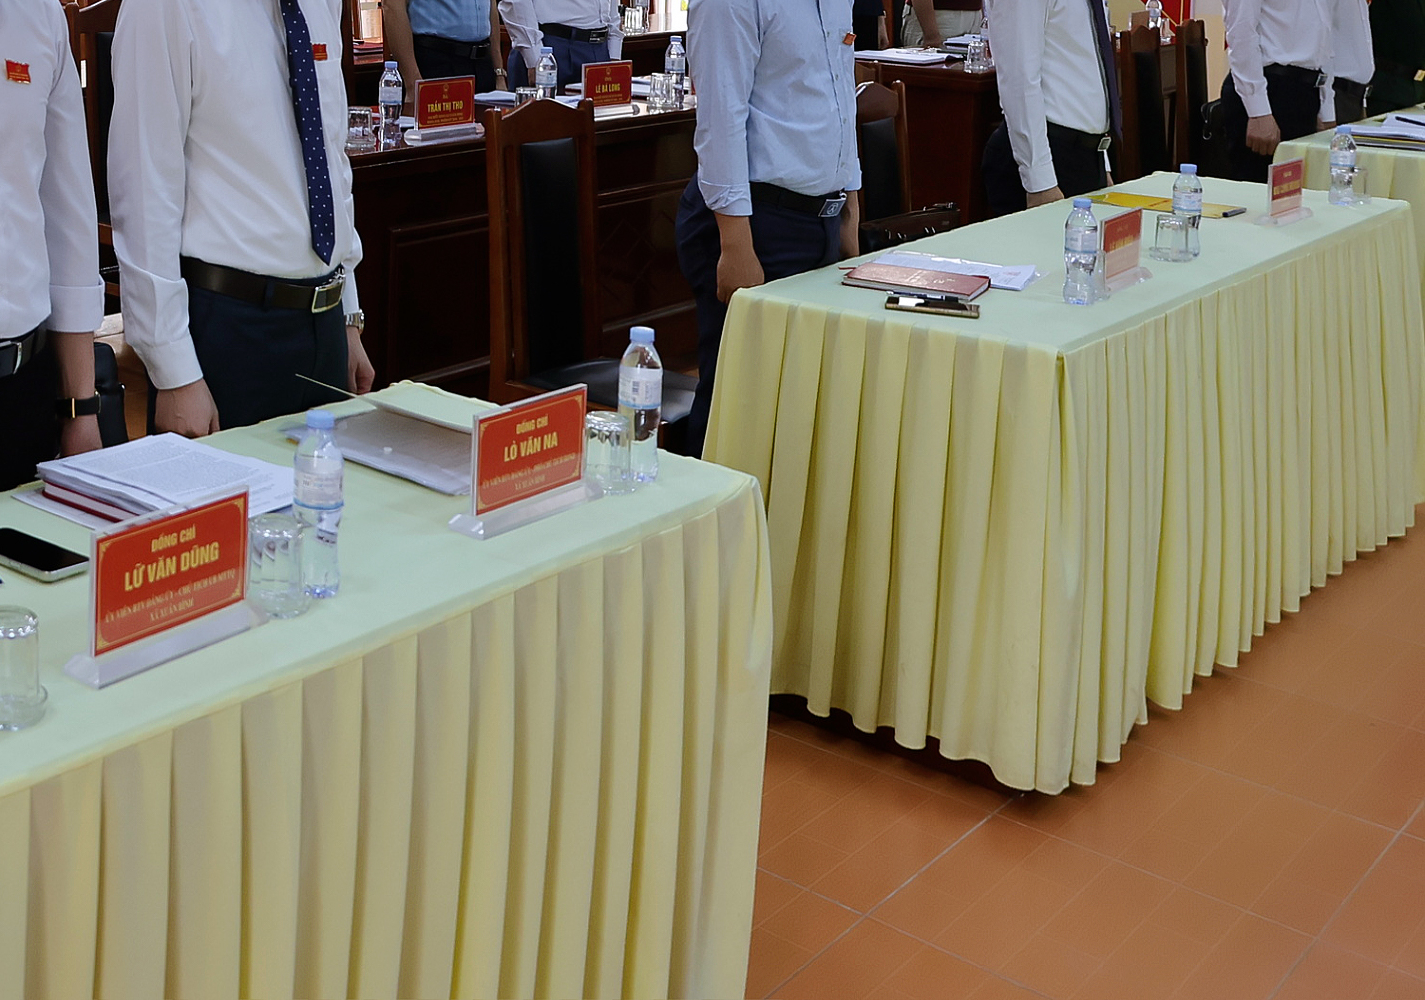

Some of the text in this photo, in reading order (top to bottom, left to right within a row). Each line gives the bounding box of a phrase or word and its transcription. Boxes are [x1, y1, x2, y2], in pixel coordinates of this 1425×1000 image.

[504, 440, 517, 462] LÒ
[520, 435, 541, 457] VĂN
[543, 432, 558, 450] NA
[151, 524, 196, 553] ĐỒNG CHÍ
[125, 563, 146, 592] LỮ
[148, 555, 176, 583] VĂN
[180, 542, 220, 571] DŨNG
